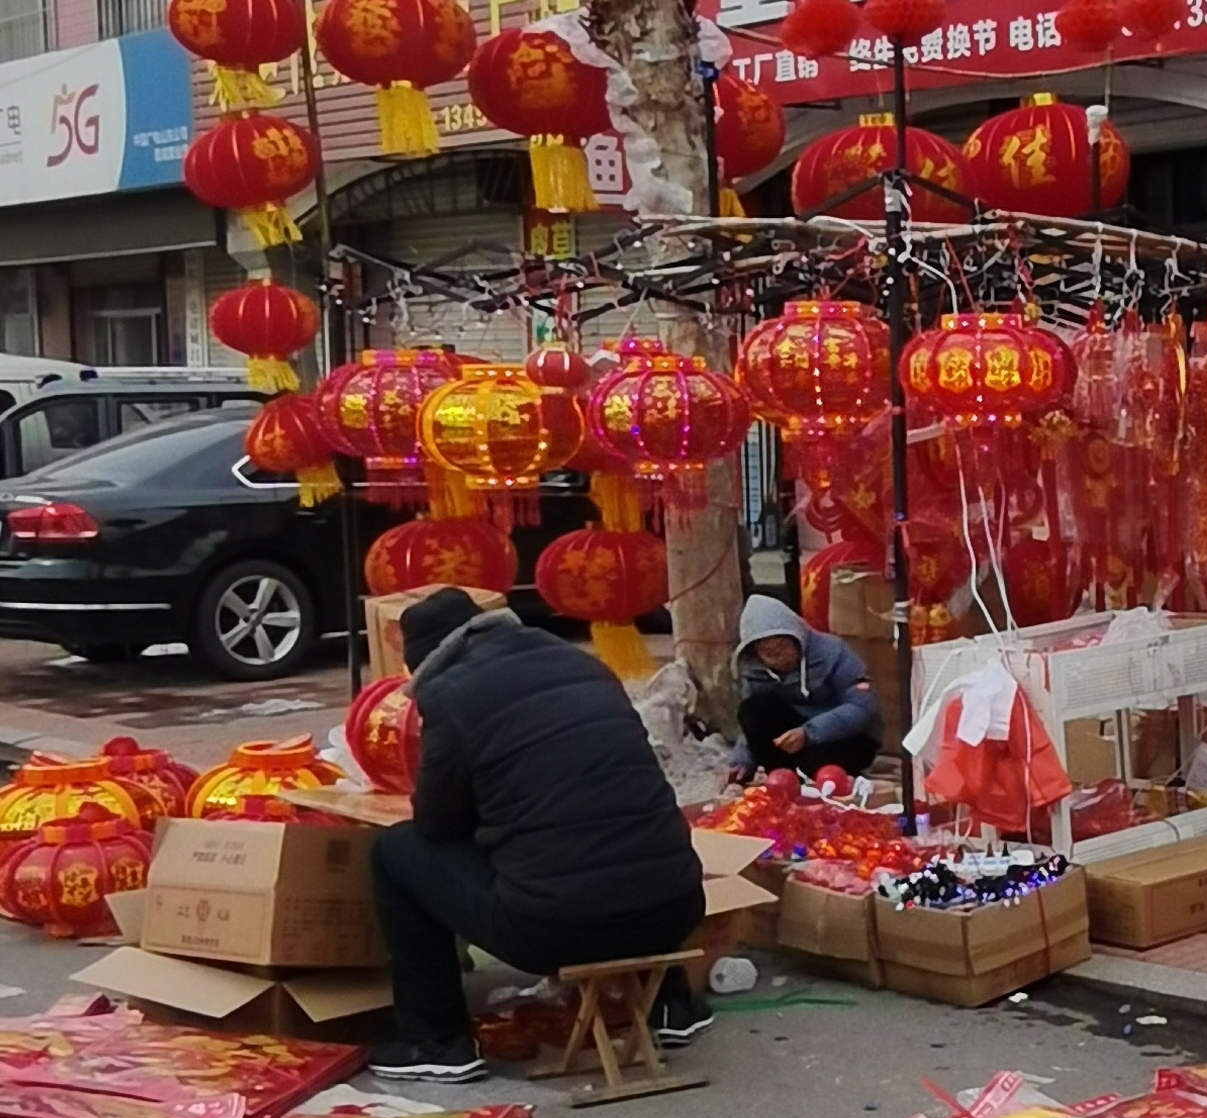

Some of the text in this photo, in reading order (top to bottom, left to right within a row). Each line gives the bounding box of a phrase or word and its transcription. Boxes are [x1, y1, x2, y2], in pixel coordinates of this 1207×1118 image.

[732, 49, 818, 86] 工厂直销
[849, 11, 1062, 72] 终生费换节 电话
[47, 83, 100, 167] 5G
